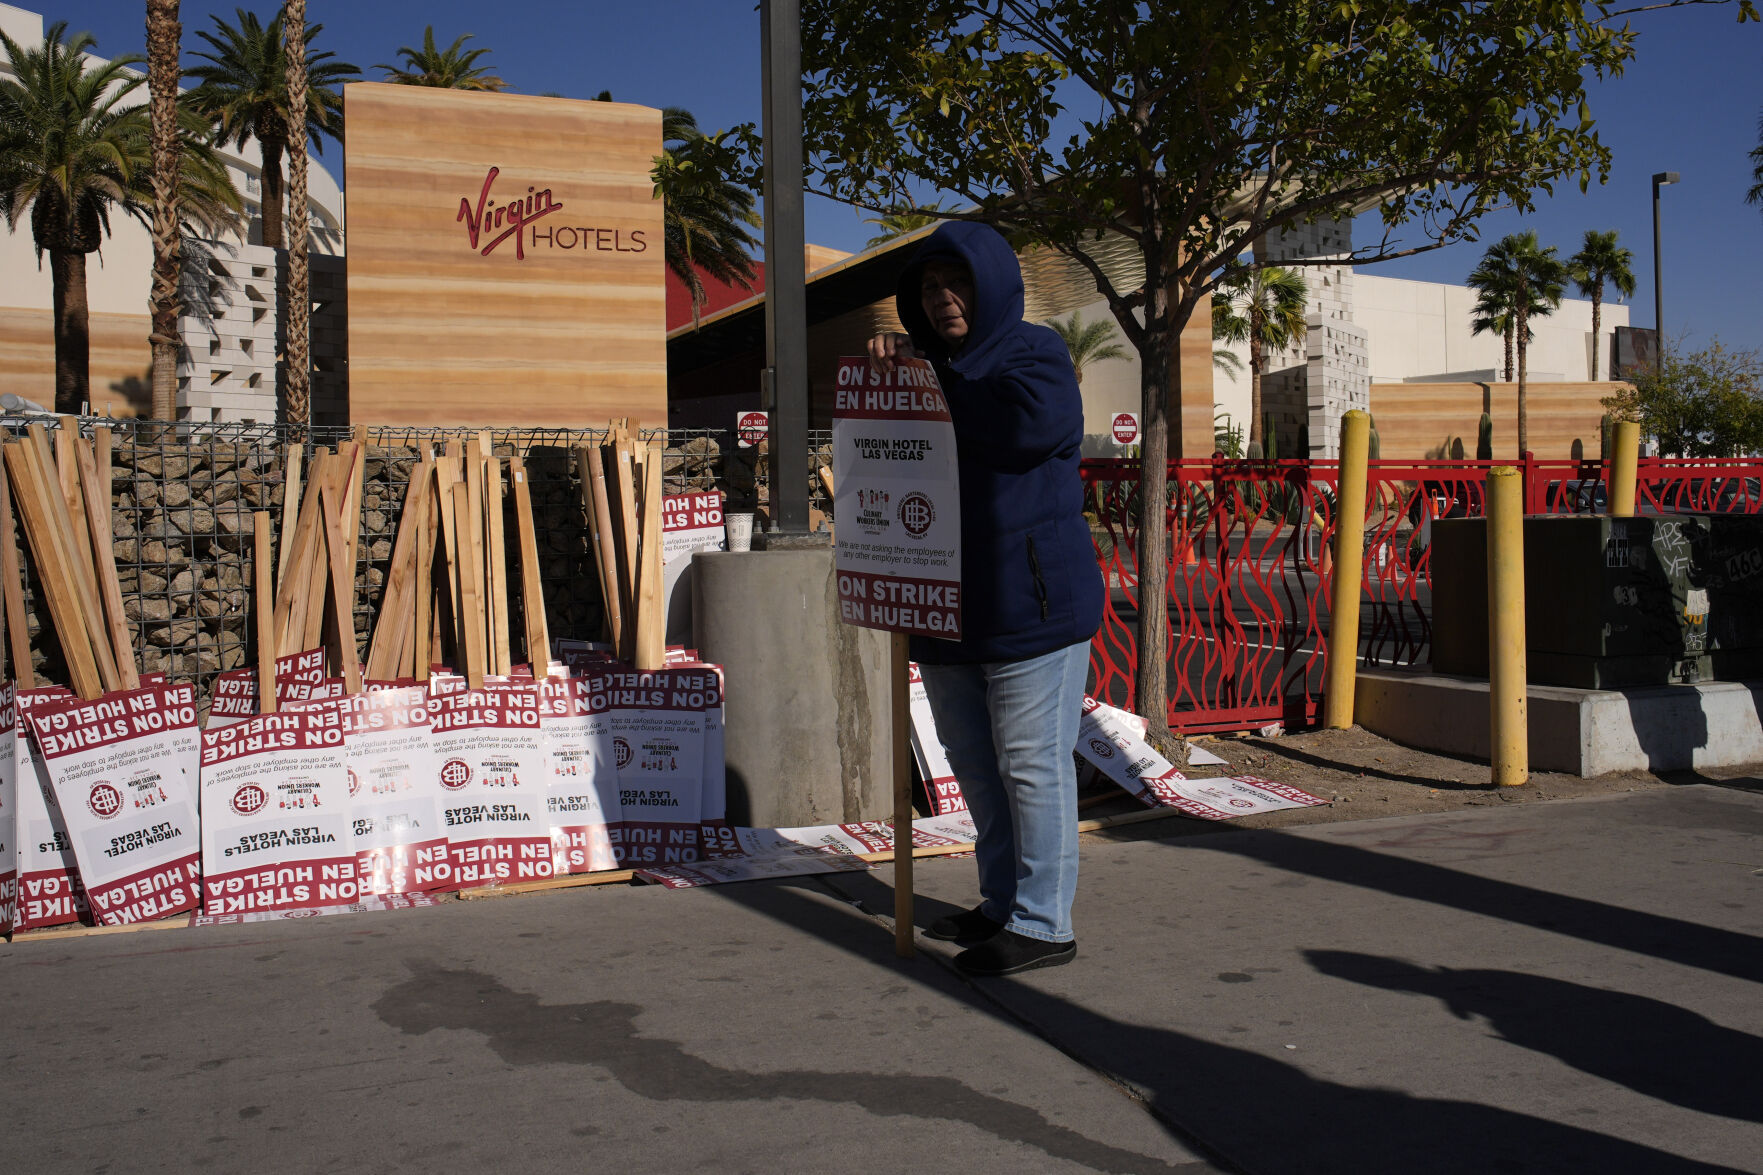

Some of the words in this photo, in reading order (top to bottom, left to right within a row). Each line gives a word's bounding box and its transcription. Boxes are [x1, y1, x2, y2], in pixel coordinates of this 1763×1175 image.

[457, 166, 563, 260] Virgin
[532, 225, 647, 253] HOTELS
[838, 366, 865, 386] ON
[869, 365, 939, 389] STRIKE
[836, 390, 859, 410] EN
[865, 391, 948, 413] HUELGA
[854, 438, 889, 449] VIRGIN
[893, 440, 933, 450] HOTEL
[862, 449, 881, 460] LAS
[884, 450, 925, 461] VEGAS
[695, 495, 720, 509] EN
[694, 510, 722, 526] ON
[838, 541, 848, 549] We
[861, 543, 871, 551] not
[871, 545, 893, 554] asking
[895, 546, 905, 554] the
[907, 547, 946, 558] employees
[947, 549, 954, 558] of
[844, 551, 855, 559] any
[856, 552, 871, 560] other
[872, 553, 902, 564] employer
[913, 557, 928, 566] stop
[839, 576, 866, 598] ON
[873, 580, 959, 609] STRIKE
[842, 600, 865, 621] EN
[871, 604, 958, 633] HUELGA
[298, 651, 322, 670] EN
[286, 683, 311, 698] EN
[575, 677, 604, 694] EN
[676, 675, 704, 690] EN
[128, 693, 156, 712] EN
[164, 688, 192, 706] EN
[394, 690, 424, 708] EN
[507, 694, 536, 708] EN
[574, 694, 607, 713] ON
[671, 692, 704, 707] ON
[34, 700, 126, 733] HUELGA
[131, 712, 163, 733] ON
[163, 707, 195, 726] ON
[306, 712, 340, 729] EN
[391, 707, 427, 726] ON
[429, 709, 498, 729] STRIK
[505, 710, 538, 724] ON
[41, 720, 129, 755] STRIKE
[203, 716, 300, 747] HUELGA
[305, 729, 342, 746] ON
[137, 746, 153, 756] other
[153, 743, 165, 751] any
[163, 749, 172, 758] We
[203, 732, 297, 763] STRIKE
[477, 742, 500, 750] asking
[97, 757, 106, 765] to
[108, 750, 137, 763] employer
[118, 756, 139, 768] asking
[139, 755, 150, 763] not
[262, 757, 298, 769] employer
[300, 757, 320, 765] other
[82, 761, 97, 770] stop
[106, 764, 118, 773] the
[232, 765, 250, 775] stop
[258, 768, 272, 778] the
[273, 766, 298, 775] asking
[299, 764, 312, 772] not
[328, 761, 342, 770] We
[58, 776, 66, 785] of
[66, 767, 105, 781] employees
[215, 769, 257, 784] employees
[205, 778, 215, 788] of
[1154, 779, 1177, 798] ON
[568, 795, 589, 804] LAS
[640, 798, 679, 807] VIRGIN
[445, 805, 488, 818] VEGAS
[492, 804, 516, 813] LAS
[486, 813, 530, 821] VIRGIN
[151, 821, 171, 834] LAS
[292, 826, 320, 837] LAS
[110, 828, 150, 847] VEGAS
[145, 827, 182, 846] VIRGIN
[239, 829, 289, 846] VEGAS
[286, 834, 336, 846] VIRGIN
[669, 829, 697, 844] EN
[718, 827, 738, 851] ON
[104, 840, 144, 858] HOTEL
[224, 838, 281, 857] HOTELS
[415, 845, 448, 864] EN
[451, 844, 513, 864] HUEL
[520, 843, 550, 859] EN
[664, 846, 698, 863] ON
[321, 863, 355, 880] EN
[415, 863, 452, 884] ON
[454, 862, 510, 883] STRI
[518, 861, 552, 877] ON
[94, 867, 182, 910] HUELGA
[207, 867, 313, 897] HUELGA
[319, 881, 357, 900] ON
[103, 888, 187, 926] STRIKE
[207, 885, 310, 915] STRIKE
